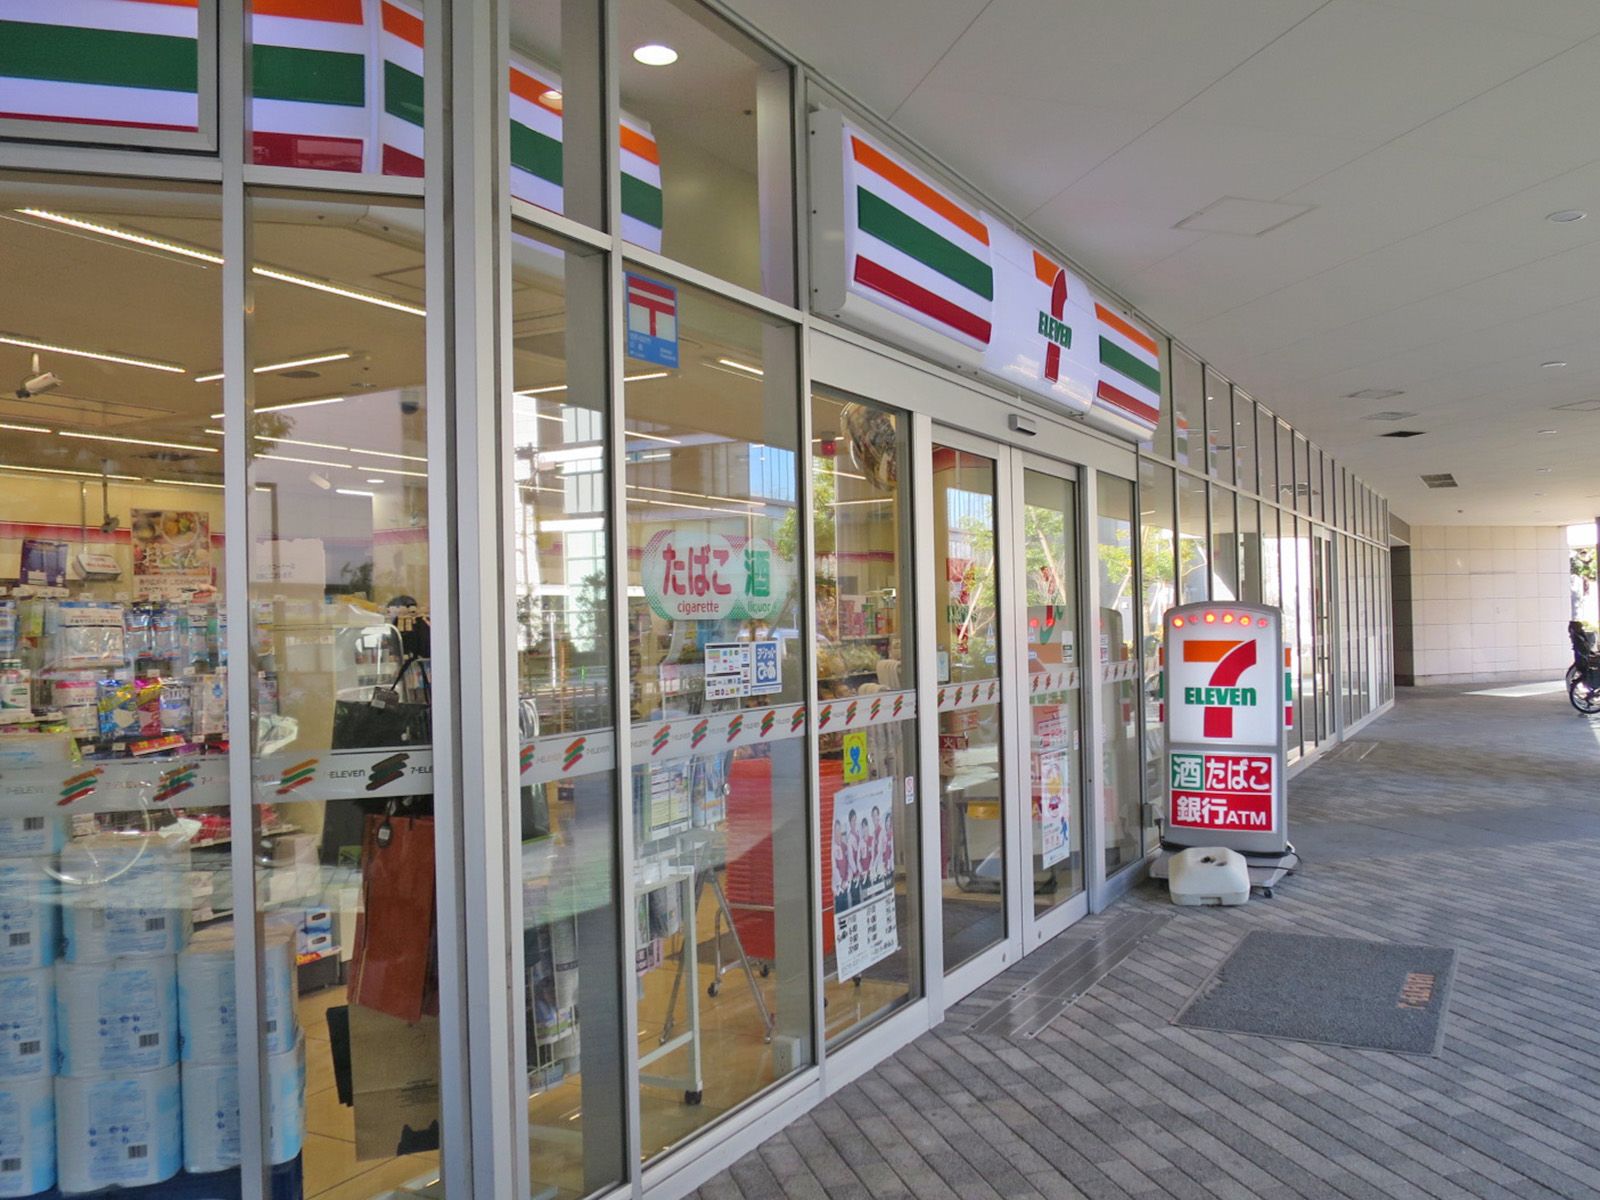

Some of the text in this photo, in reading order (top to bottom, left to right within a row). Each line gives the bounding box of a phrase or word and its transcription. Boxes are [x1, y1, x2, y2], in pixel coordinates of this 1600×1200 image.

[662, 543, 770, 597] たばこ 酒
[677, 600, 720, 615] cigarette
[1173, 756, 1270, 791] 酒 たばこ
